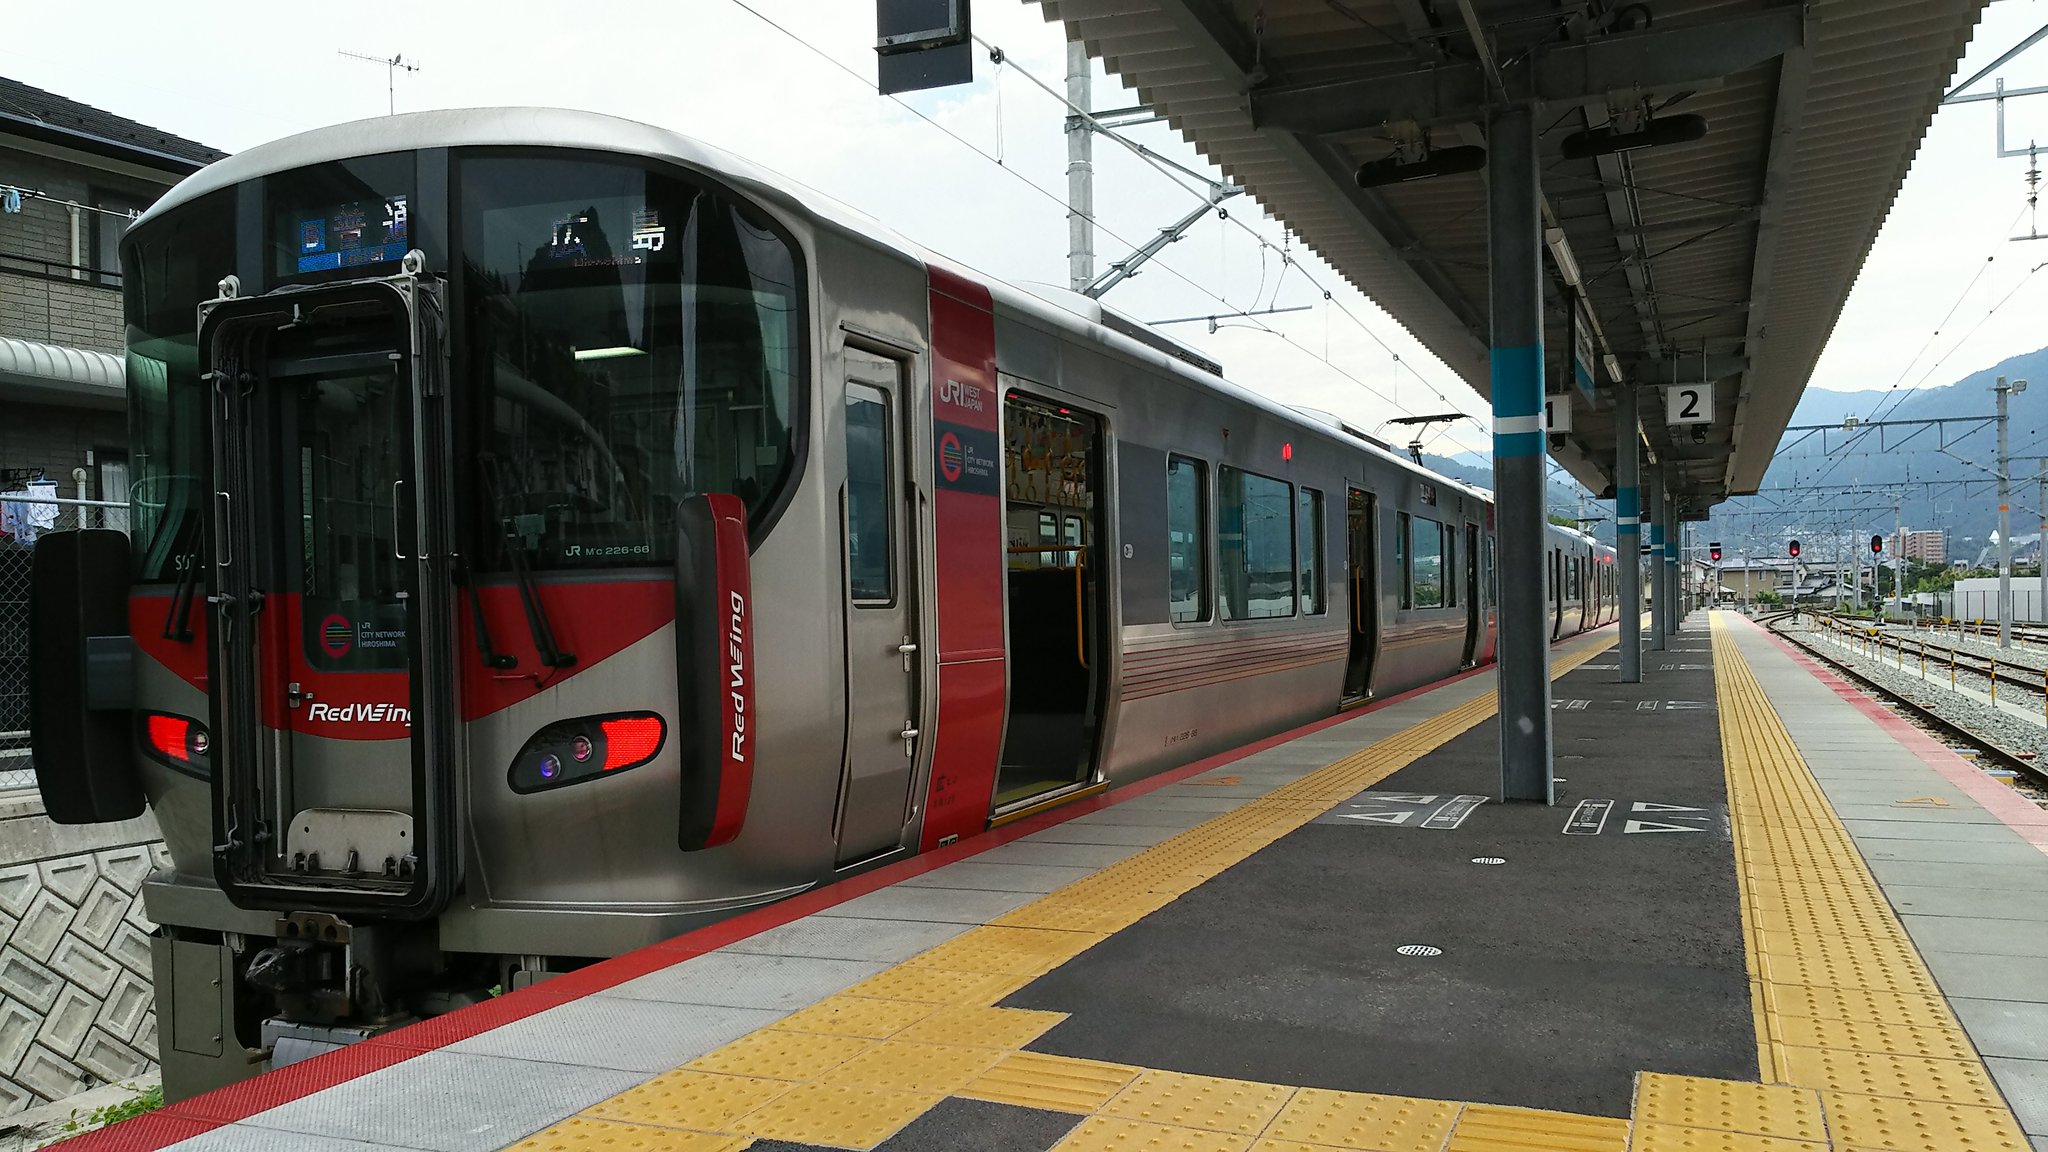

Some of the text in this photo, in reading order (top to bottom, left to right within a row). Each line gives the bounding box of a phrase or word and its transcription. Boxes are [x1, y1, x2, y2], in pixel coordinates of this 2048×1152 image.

[940, 379, 960, 406] JR
[963, 384, 981, 399] WEST
[963, 397, 983, 413] JAPAN
[1679, 390, 1700, 419] 2
[1545, 401, 1554, 428] 1
[565, 545, 581, 557] JR
[605, 545, 650, 555] 226-66
[361, 621, 371, 630] JR
[361, 630, 406, 639] CITY NETWORK
[361, 640, 396, 648] HIROSHIMA
